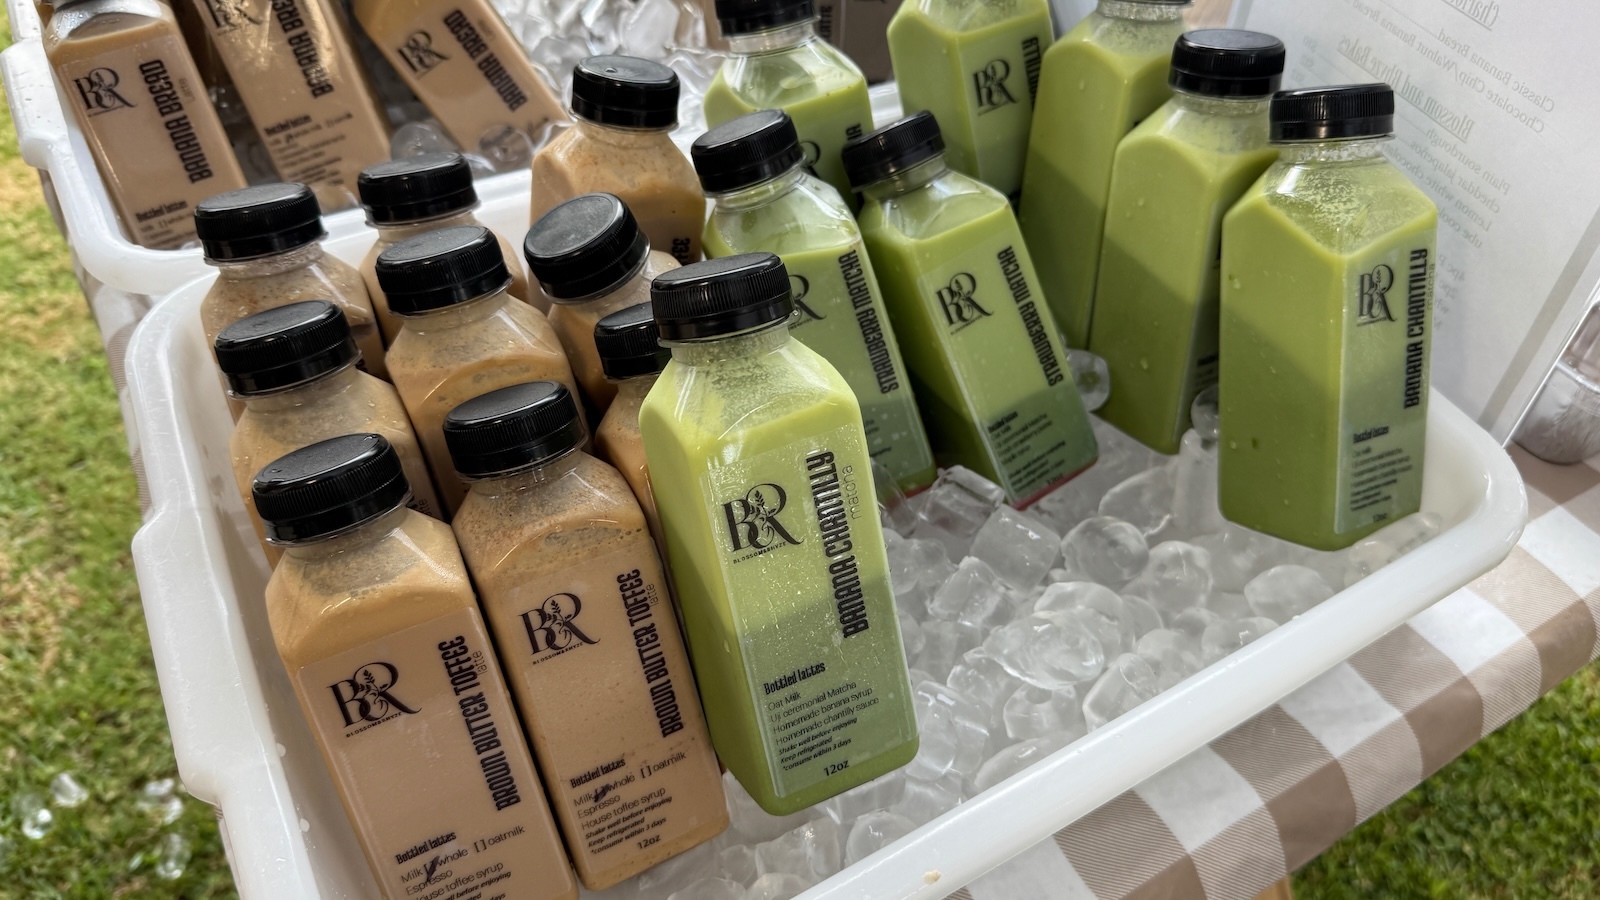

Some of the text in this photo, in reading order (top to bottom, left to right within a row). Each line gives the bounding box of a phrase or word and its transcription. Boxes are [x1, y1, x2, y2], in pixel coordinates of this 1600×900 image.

[272, 0, 303, 33] BRE
[140, 60, 184, 117] BREAD
[165, 116, 214, 183] BANANA
[838, 250, 871, 310] MATCHA
[997, 246, 1064, 387] STRAWBERRY MATCHA
[1404, 248, 1428, 409] BANANA CHANTILLY
[856, 304, 899, 395] STRAWBERRY
[842, 466, 862, 520] matcha
[806, 451, 870, 638] BANANA CHANTILLY
[472, 650, 488, 675] latte
[617, 568, 684, 738] BROWN BUTTER TOFFEE
[764, 663, 826, 695] Bottled lattes
[768, 692, 801, 710] Oat Milk
[773, 688, 872, 734] Homemade banana syrup
[783, 692, 826, 718] ceremonial
[826, 681, 856, 699] Matcha
[438, 635, 521, 810] BROWN BUTTER TOFFEE
[776, 698, 879, 746] Homemade chantilly sauce
[779, 718, 858, 755] Shake well before enjoying
[781, 736, 832, 764] Keep refrigerated
[814, 747, 832, 758] within
[838, 738, 852, 748] days
[570, 759, 626, 788] Bottled lattes
[574, 794, 594, 807] Milk
[608, 774, 636, 792] whole
[653, 752, 686, 772] oatmilk
[824, 760, 849, 776] 12oz
[578, 794, 620, 818] Espresso
[582, 788, 666, 830] House toffee syrup
[586, 796, 672, 840] Shake well before enjoying
[588, 817, 645, 847] Keep refrigerated
[624, 828, 644, 840] within
[651, 817, 666, 828] days
[638, 835, 661, 850] 12oz
[395, 832, 456, 864] Bottled lattes
[401, 868, 424, 884] Milk
[438, 848, 468, 866] whole
[488, 826, 526, 846] oatmilk
[406, 869, 453, 896] Espresso
[416, 888, 444, 900] ouse
[446, 874, 474, 892] toffee
[476, 862, 504, 880] syrup
[456, 884, 480, 898] before
[480, 871, 512, 888] enjoying
